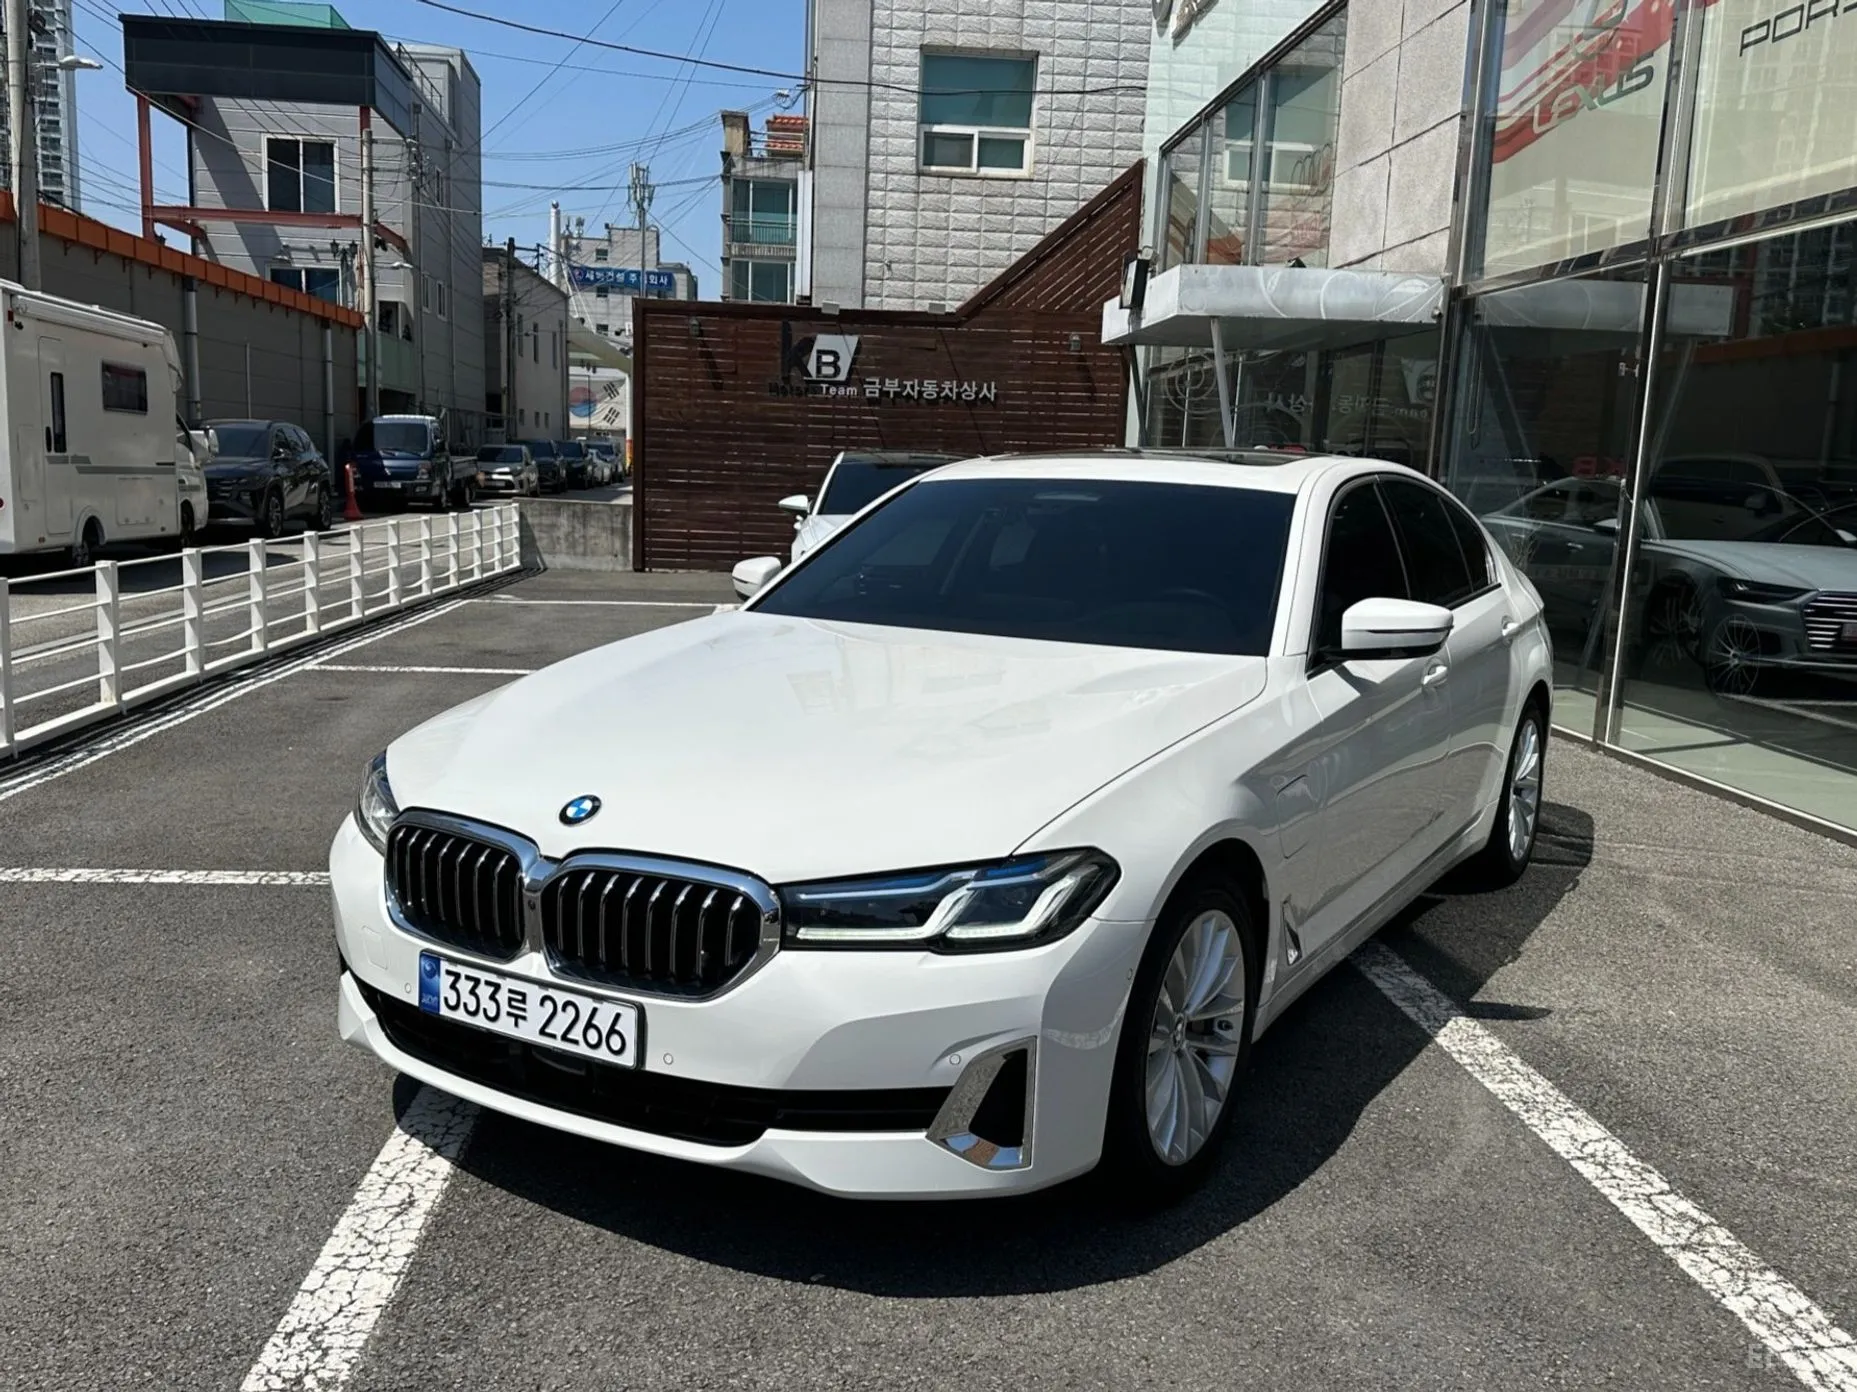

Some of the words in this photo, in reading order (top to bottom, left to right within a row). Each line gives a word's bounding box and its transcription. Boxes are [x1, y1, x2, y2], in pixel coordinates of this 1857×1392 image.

[1739, 0, 1857, 57] POR
[1532, 50, 1655, 135] LEXUS
[820, 383, 858, 397] Team
[863, 376, 998, 402] 금부자동차상사
[443, 969, 528, 1028] 333루
[538, 995, 627, 1056] 2266
